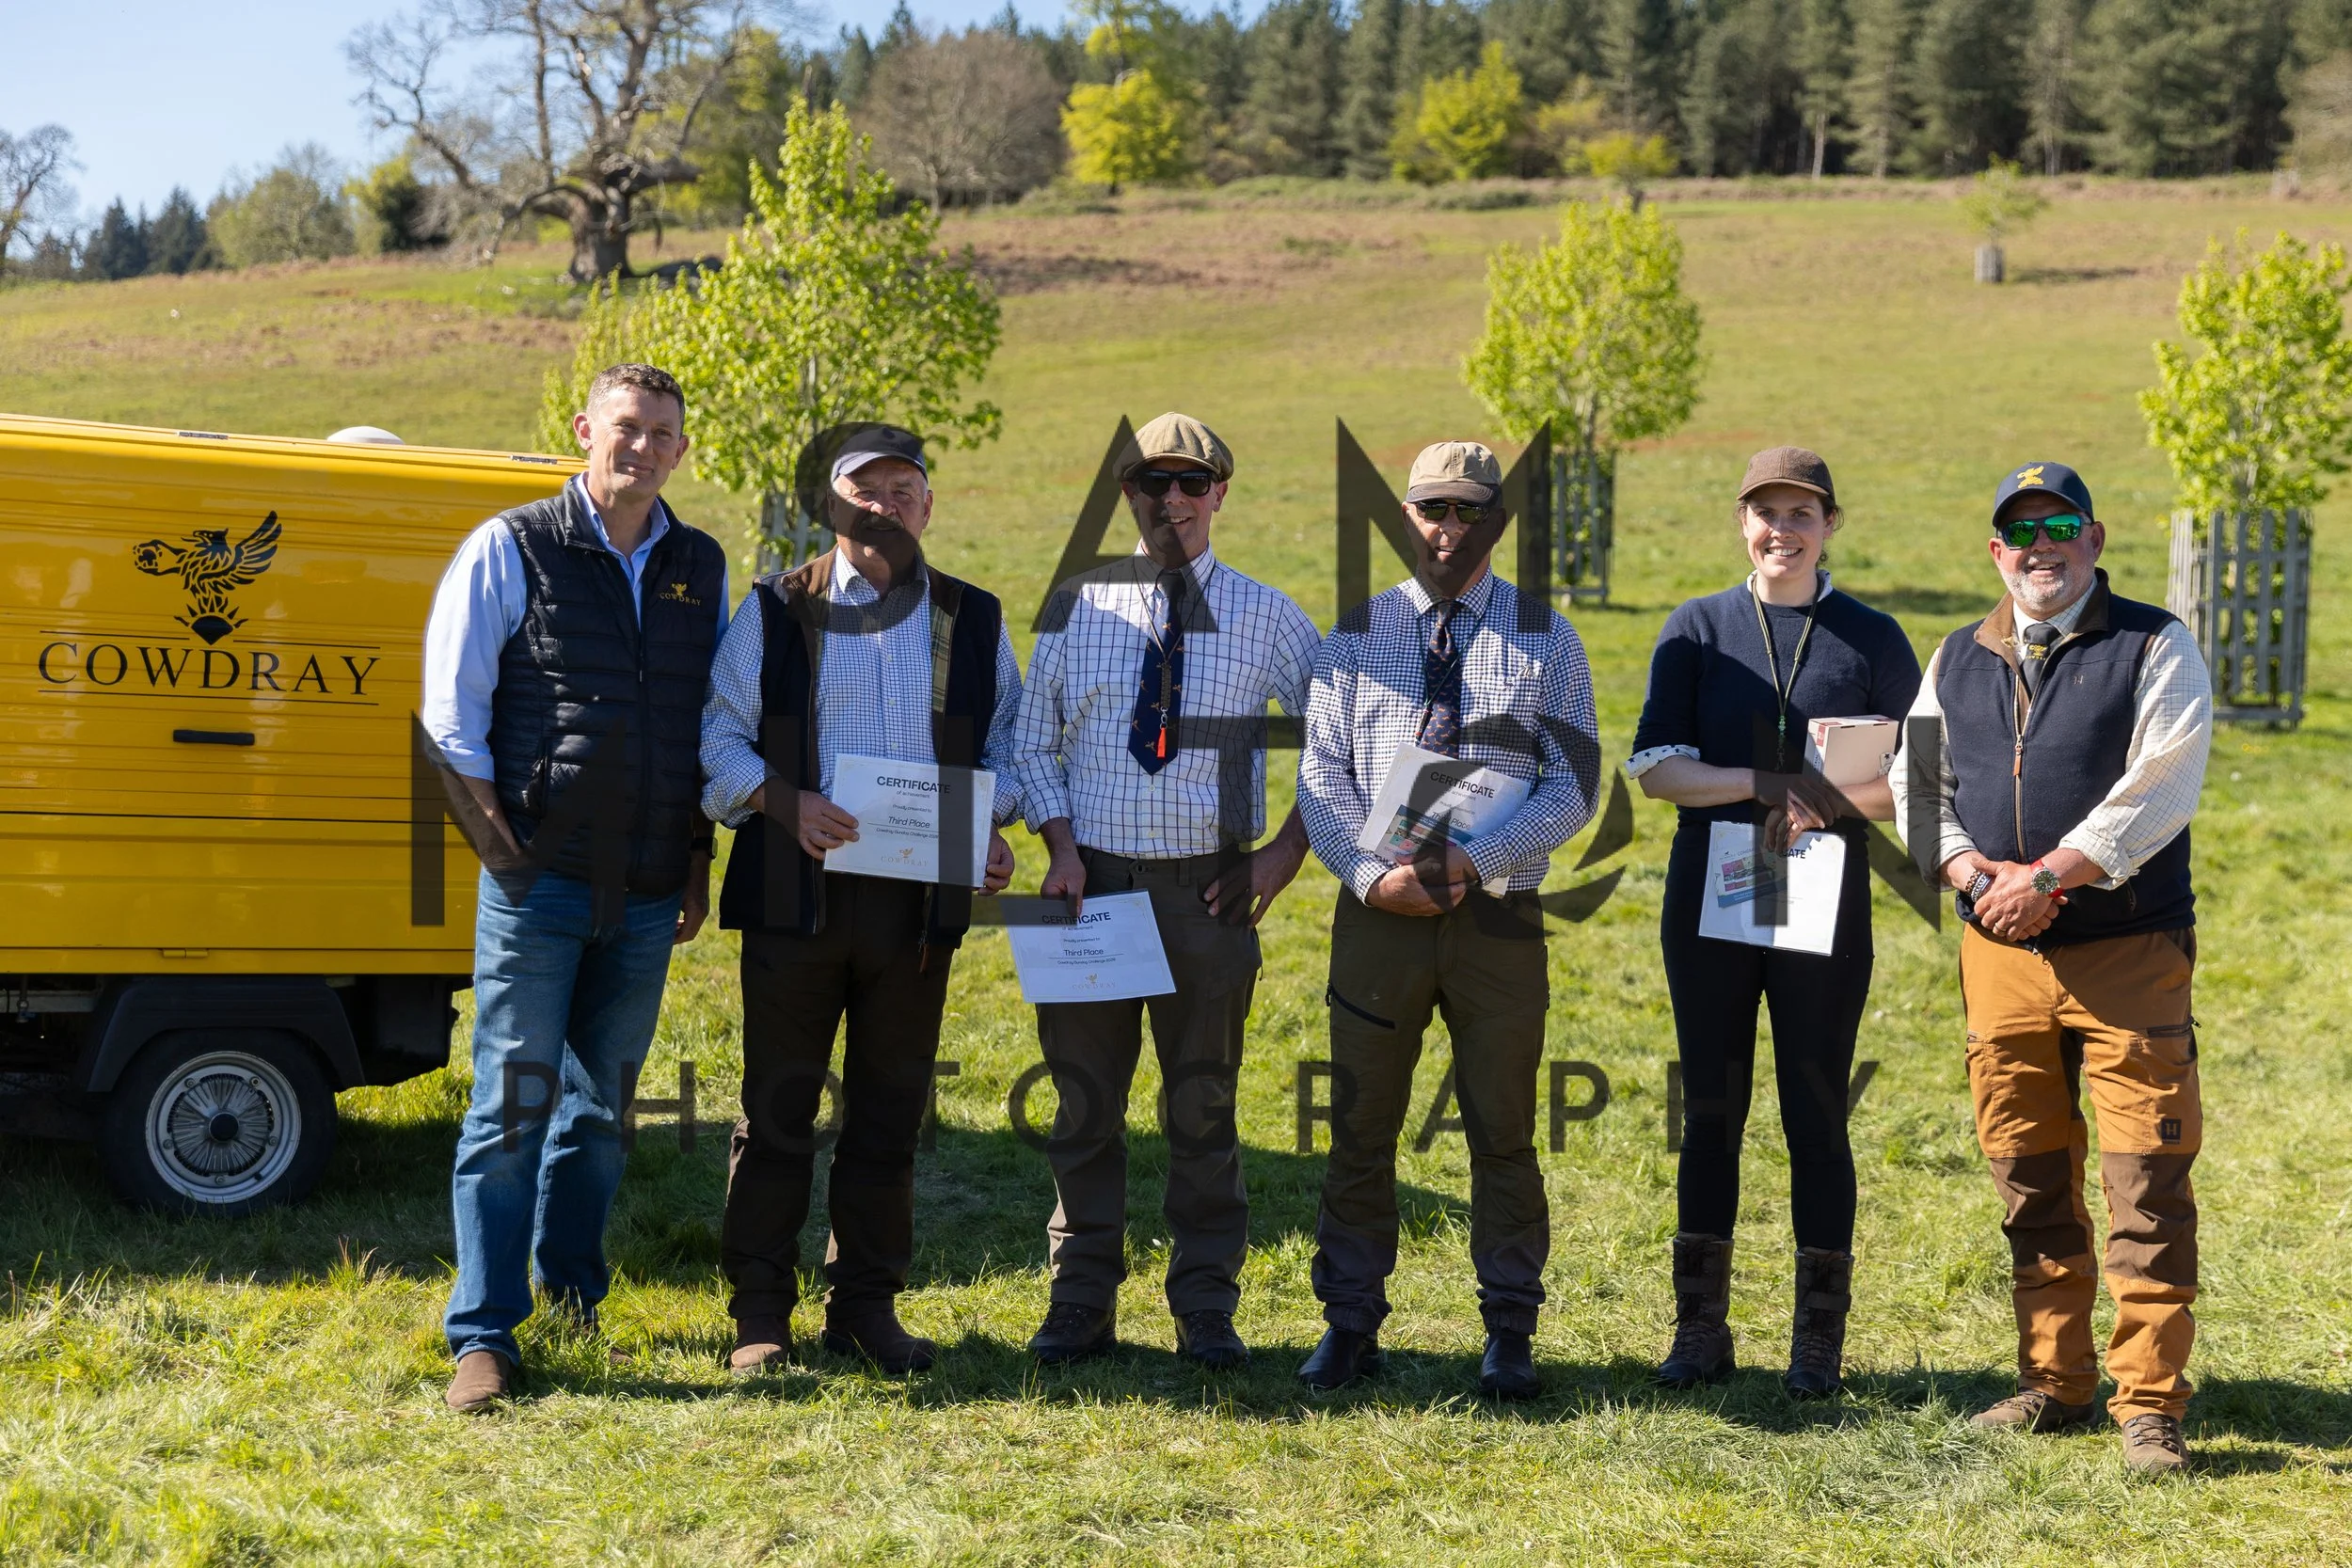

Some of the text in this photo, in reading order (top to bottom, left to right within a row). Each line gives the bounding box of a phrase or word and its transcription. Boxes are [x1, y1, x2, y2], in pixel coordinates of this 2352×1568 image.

[660, 592, 701, 606] COWDRAY
[39, 641, 381, 695] COWDRAY
[877, 775, 952, 794] CERTIFICATE
[1430, 771, 1496, 799] CERTIFICATE
[888, 816, 930, 829] Third Place
[881, 856, 929, 866] COWDRAY
[1041, 911, 1111, 925] CERTIFICATE
